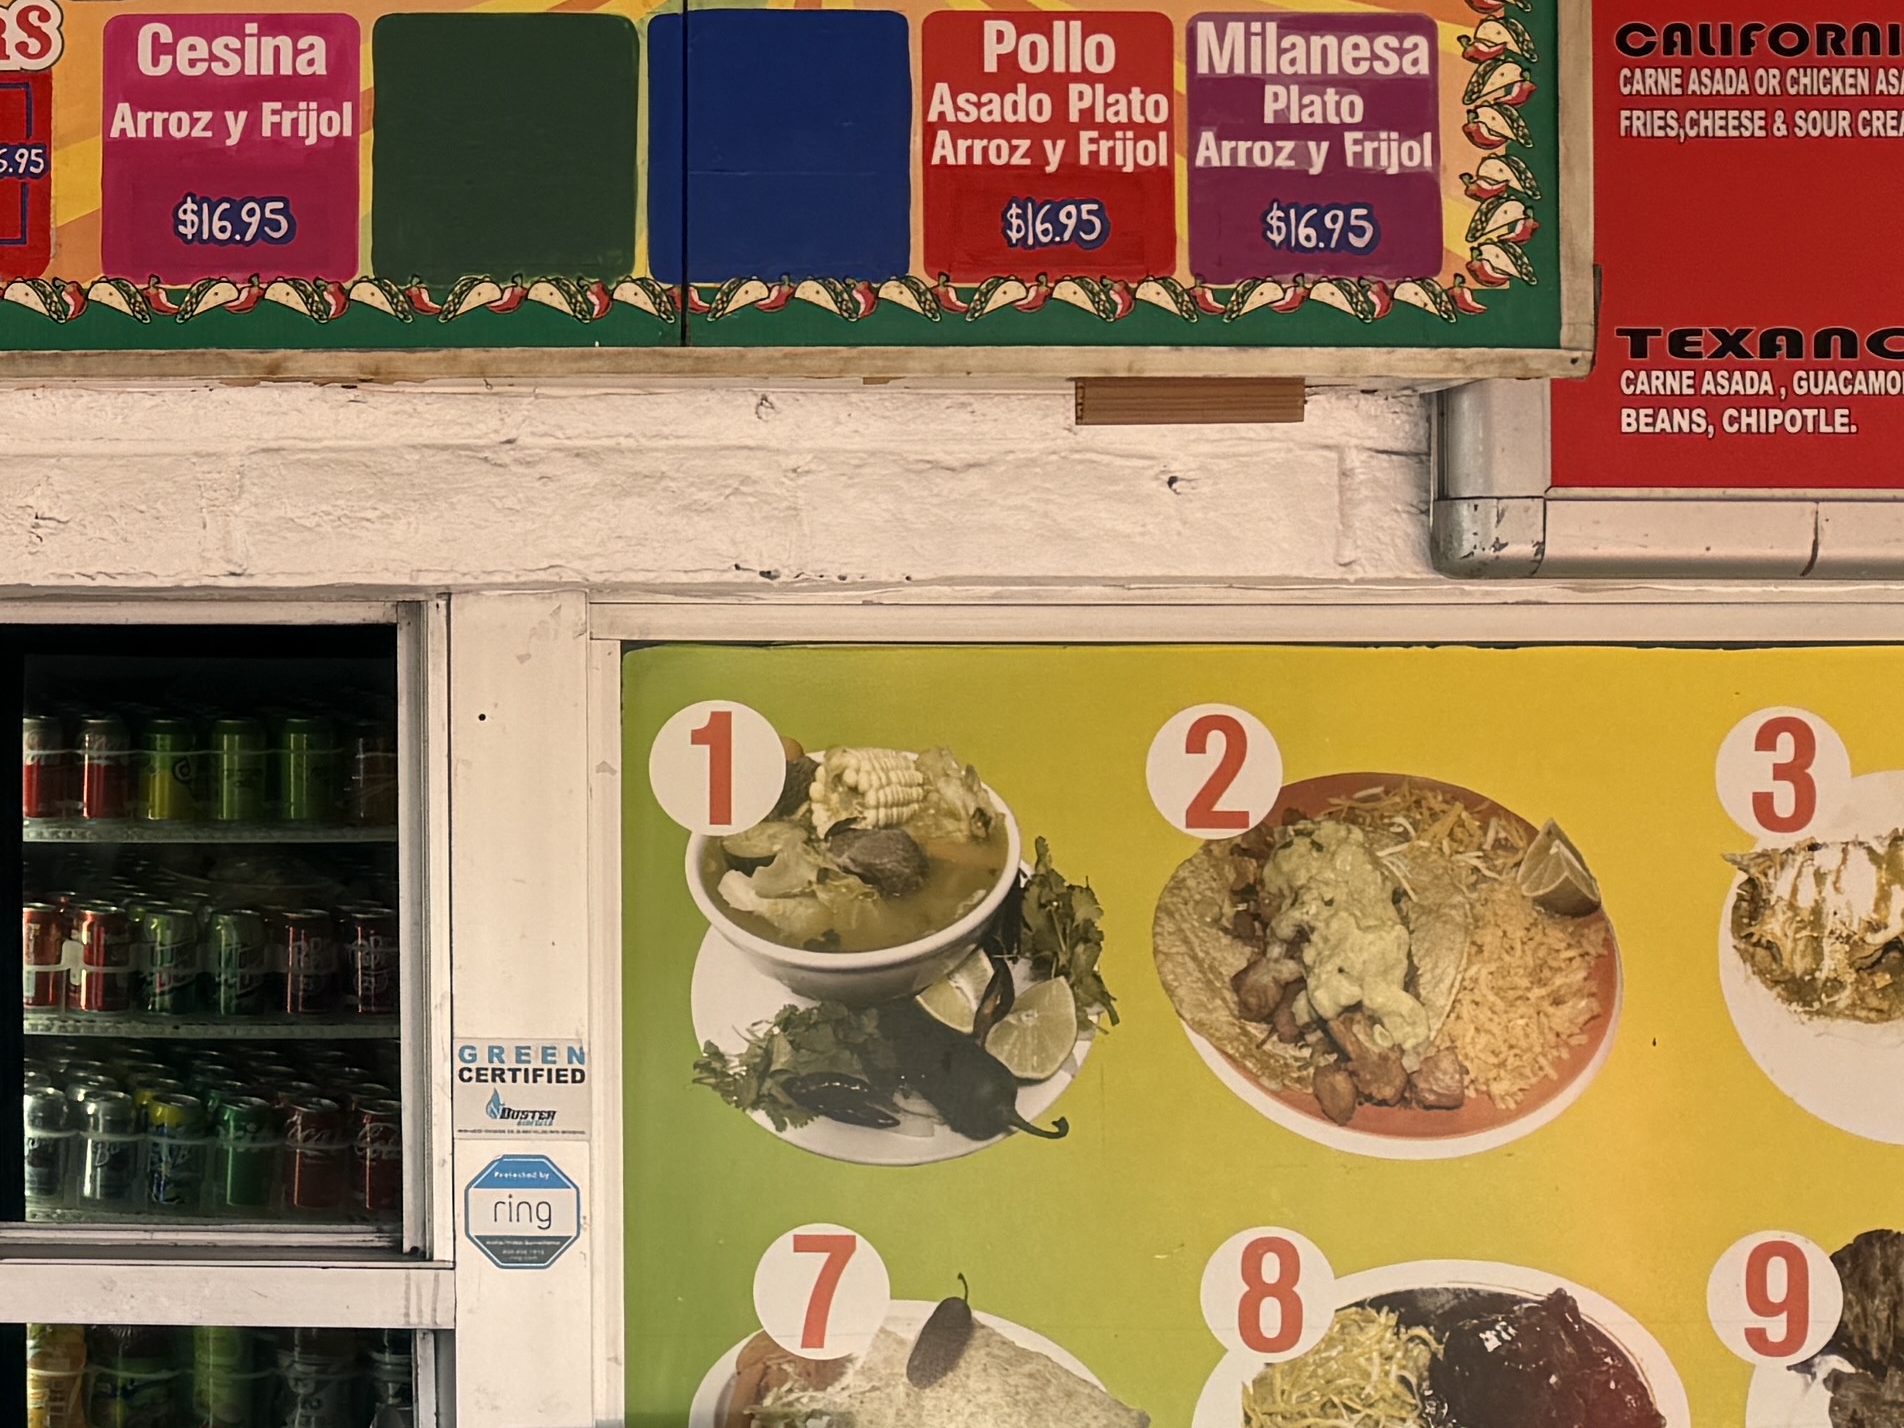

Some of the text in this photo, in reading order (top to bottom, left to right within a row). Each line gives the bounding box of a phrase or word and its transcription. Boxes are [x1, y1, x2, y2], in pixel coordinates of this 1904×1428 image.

[138, 23, 327, 76] Cesina
[983, 21, 1115, 72] Pollo
[1197, 21, 1429, 75] Milanesa
[111, 102, 352, 146] Arroz y Frijol
[928, 83, 1168, 123] Asado Plato
[177, 198, 287, 241] $16.95
[1621, 409, 1857, 438] BEANS, CHIPOTLE.
[690, 710, 733, 825] 1
[1184, 715, 1250, 829] 2
[1752, 717, 1818, 833] 3
[458, 1046, 585, 1064] GREEN
[458, 1068, 585, 1084] CERTIFIED
[494, 1194, 551, 1230] ring
[791, 1235, 856, 1348] 7
[1238, 1237, 1303, 1352] 8
[1744, 1241, 1810, 1356] 9
